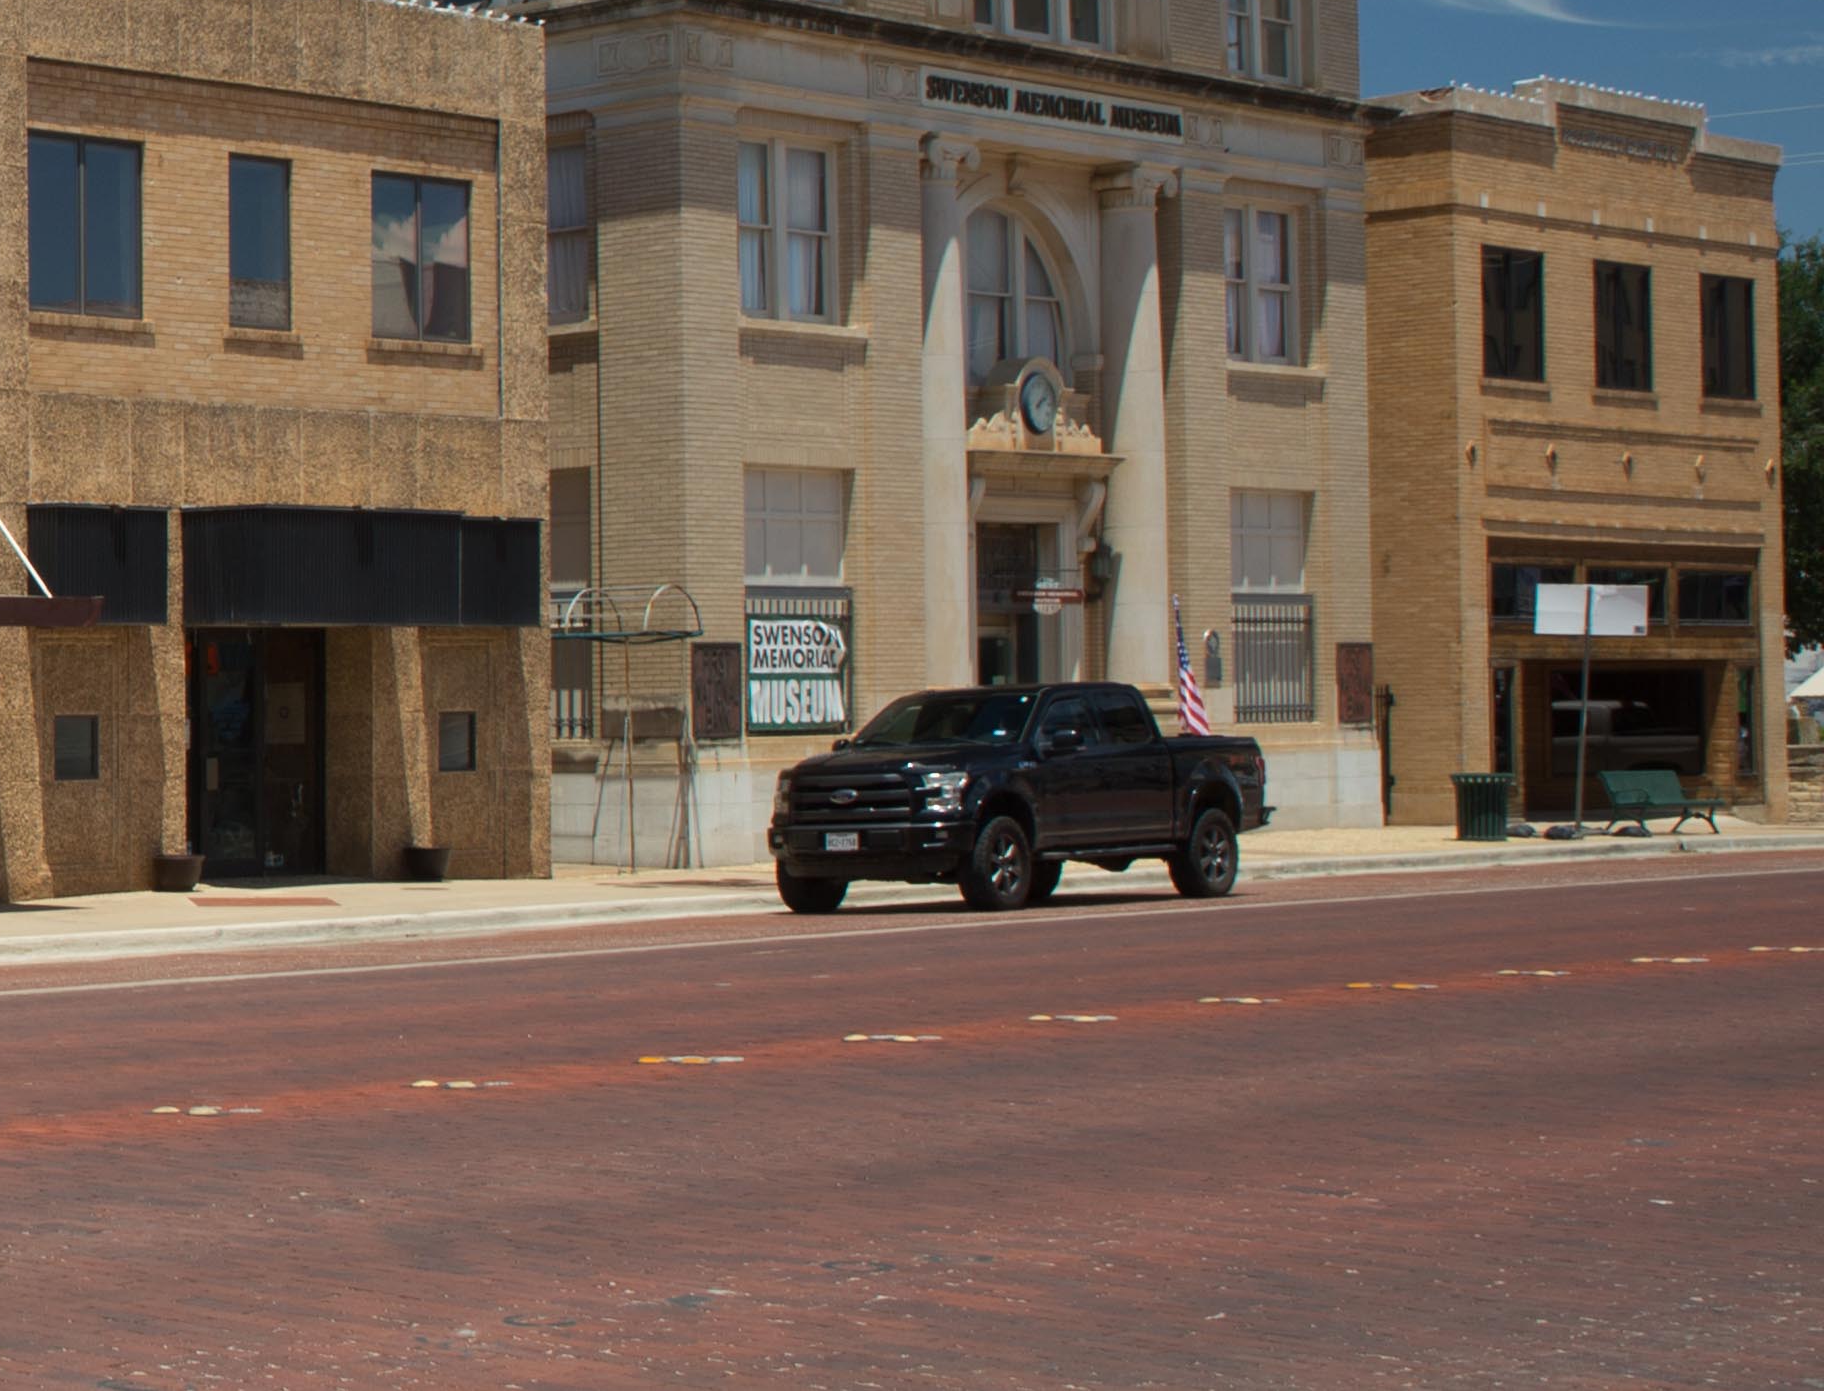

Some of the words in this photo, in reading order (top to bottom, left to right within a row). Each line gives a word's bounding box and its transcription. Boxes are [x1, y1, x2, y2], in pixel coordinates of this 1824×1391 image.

[926, 75, 1009, 111] SWENSON
[1014, 89, 1106, 126] MEMORIAL
[1109, 104, 1182, 137] MUSEUM
[753, 624, 842, 649] SWENSON
[753, 648, 837, 669] MEMORIAL
[750, 679, 845, 724] MUSEUM
